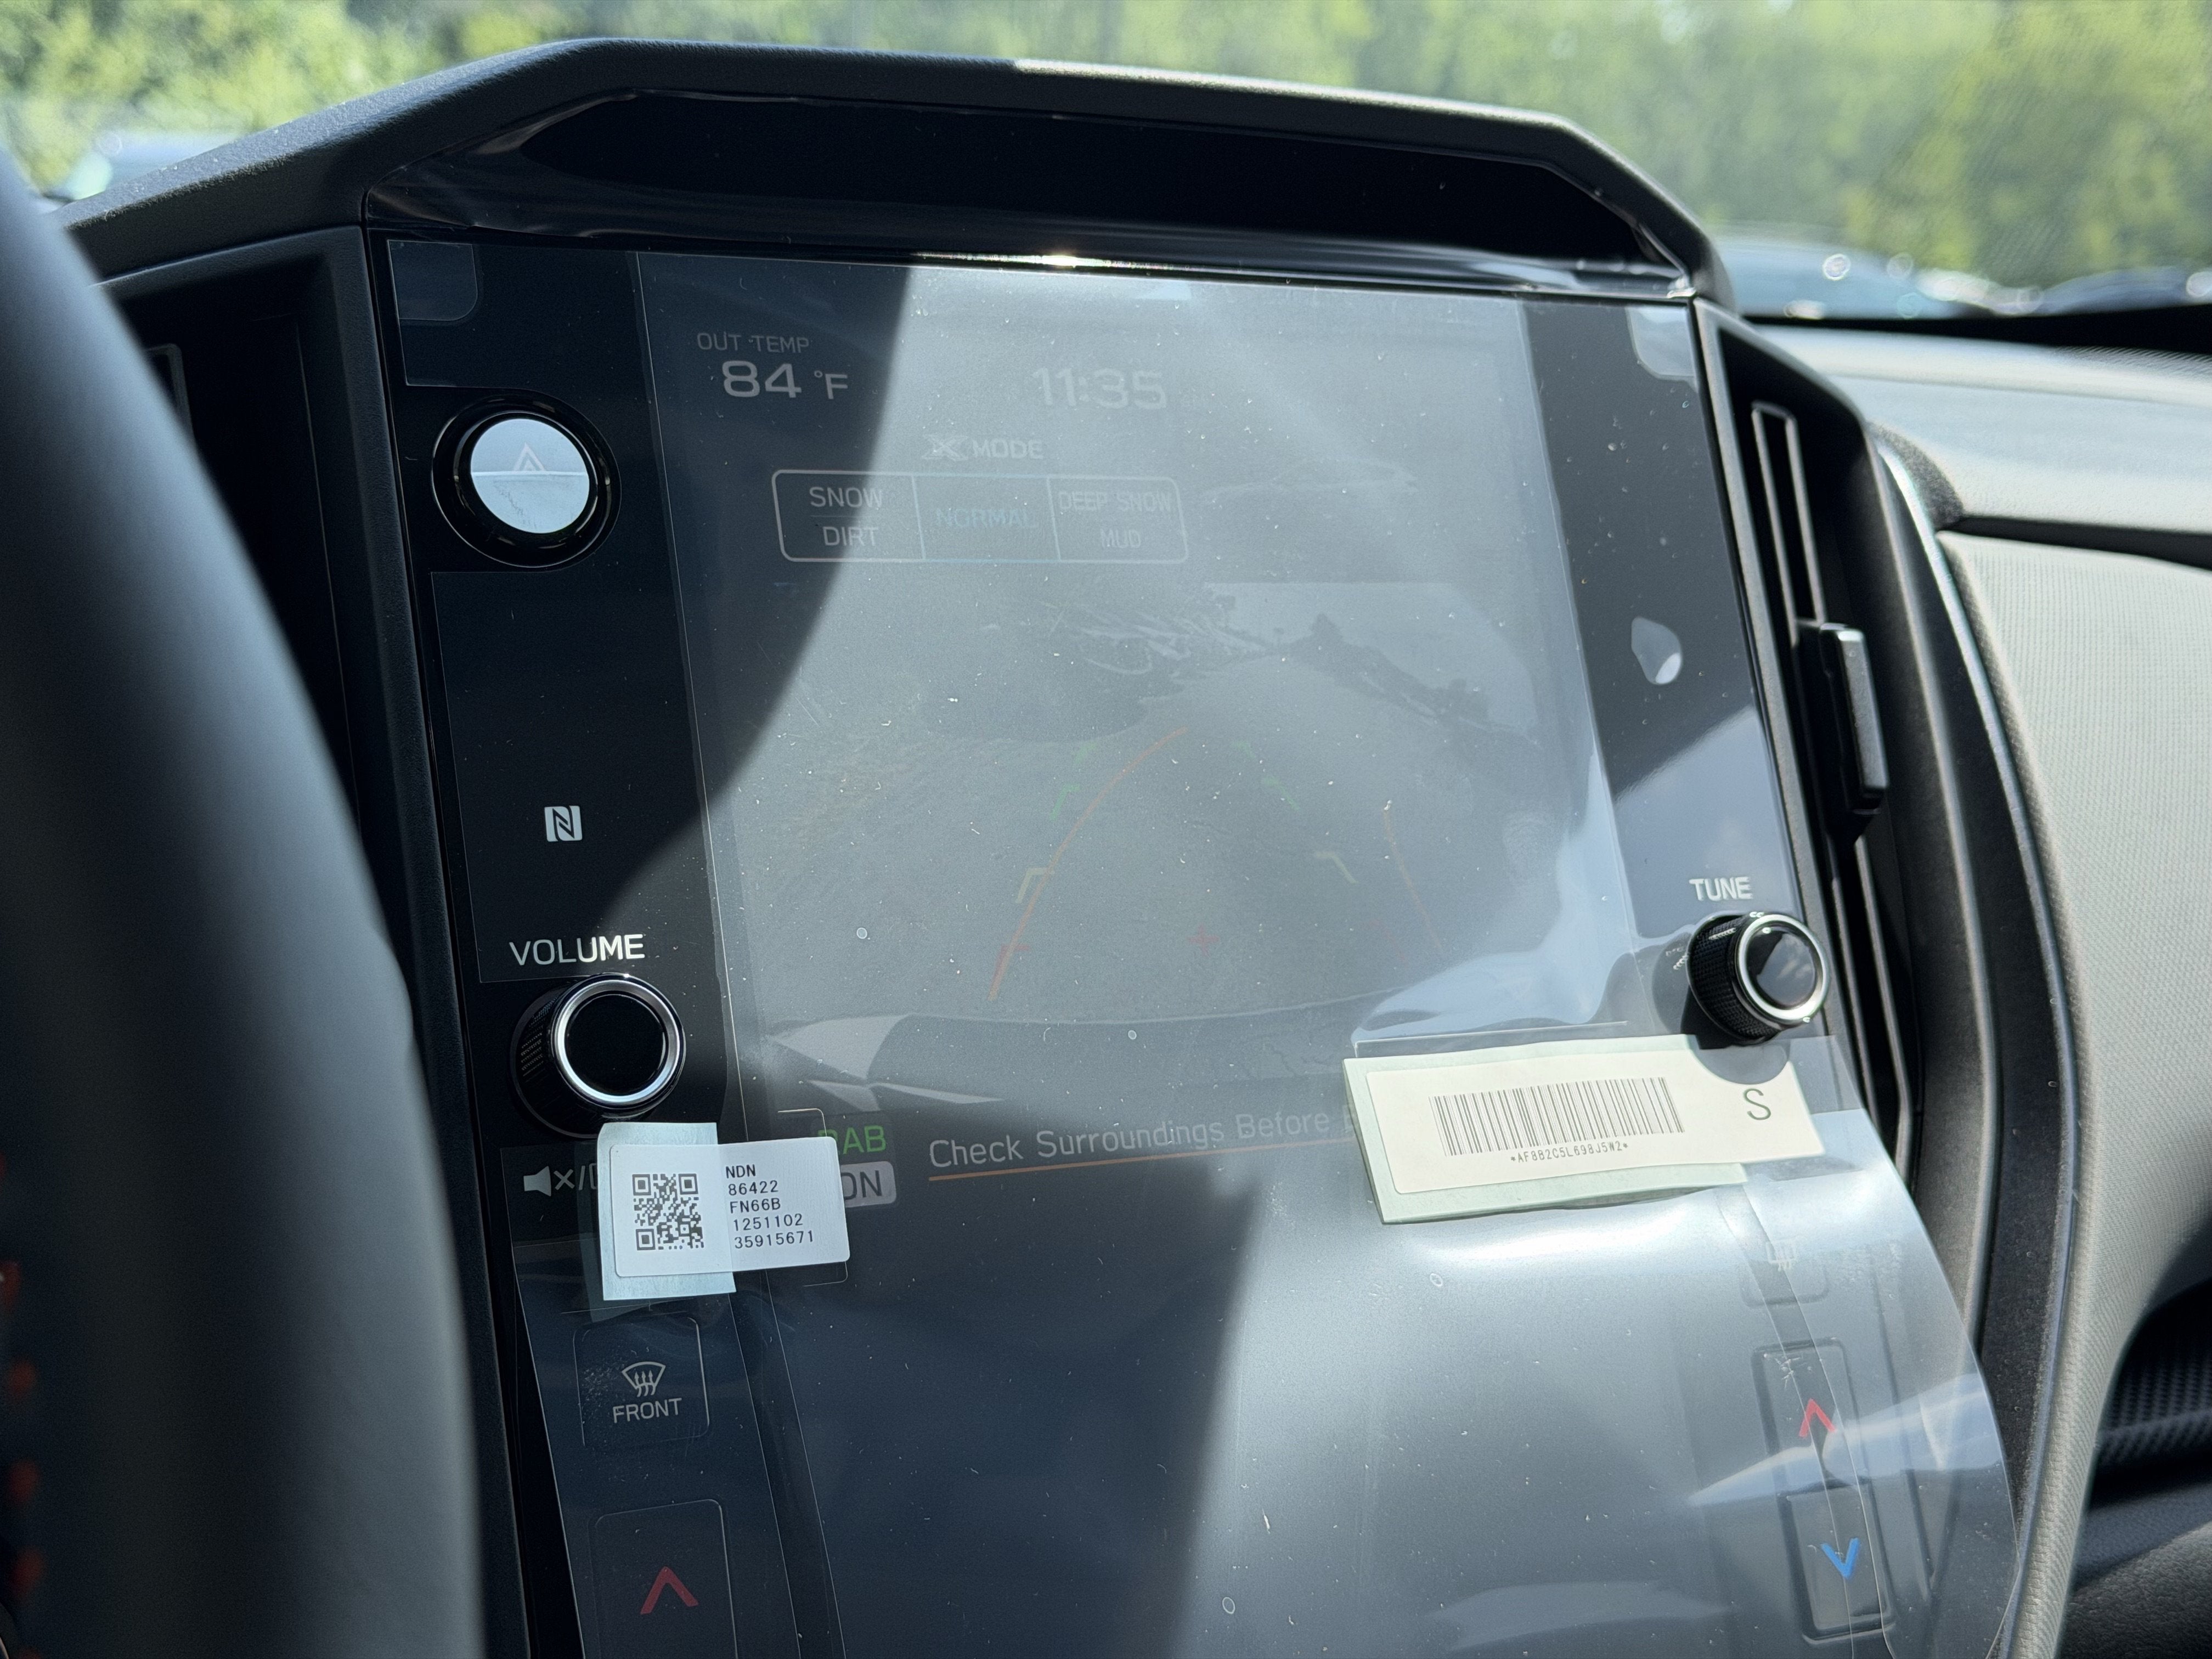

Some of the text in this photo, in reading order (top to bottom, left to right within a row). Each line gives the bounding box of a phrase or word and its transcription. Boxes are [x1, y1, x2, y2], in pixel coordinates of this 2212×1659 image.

[697, 331, 809, 353] OUT TEMP
[721, 360, 802, 398] 84
[1032, 367, 1167, 410] 11:35
[972, 438, 1044, 460] MODE
[809, 486, 883, 507] SNOW
[1057, 490, 1172, 512] DEEP SNOW
[935, 507, 1039, 529] NORMAL
[823, 526, 878, 546] DIRT
[1099, 528, 1142, 549] MUD
[1689, 876, 1754, 901] TUNE
[509, 934, 646, 966] VOLUME
[1743, 1088, 1771, 1120] S
[929, 1134, 1024, 1167] Check
[1036, 1120, 1225, 1158] Surroundings
[1234, 1111, 1330, 1139] Before
[725, 1164, 756, 1179] NDN
[728, 1180, 779, 1196] 86422
[730, 1198, 781, 1214] FN66B
[733, 1213, 803, 1232] 1251102
[734, 1230, 813, 1249] 35915671
[612, 1397, 682, 1424] FRONT
